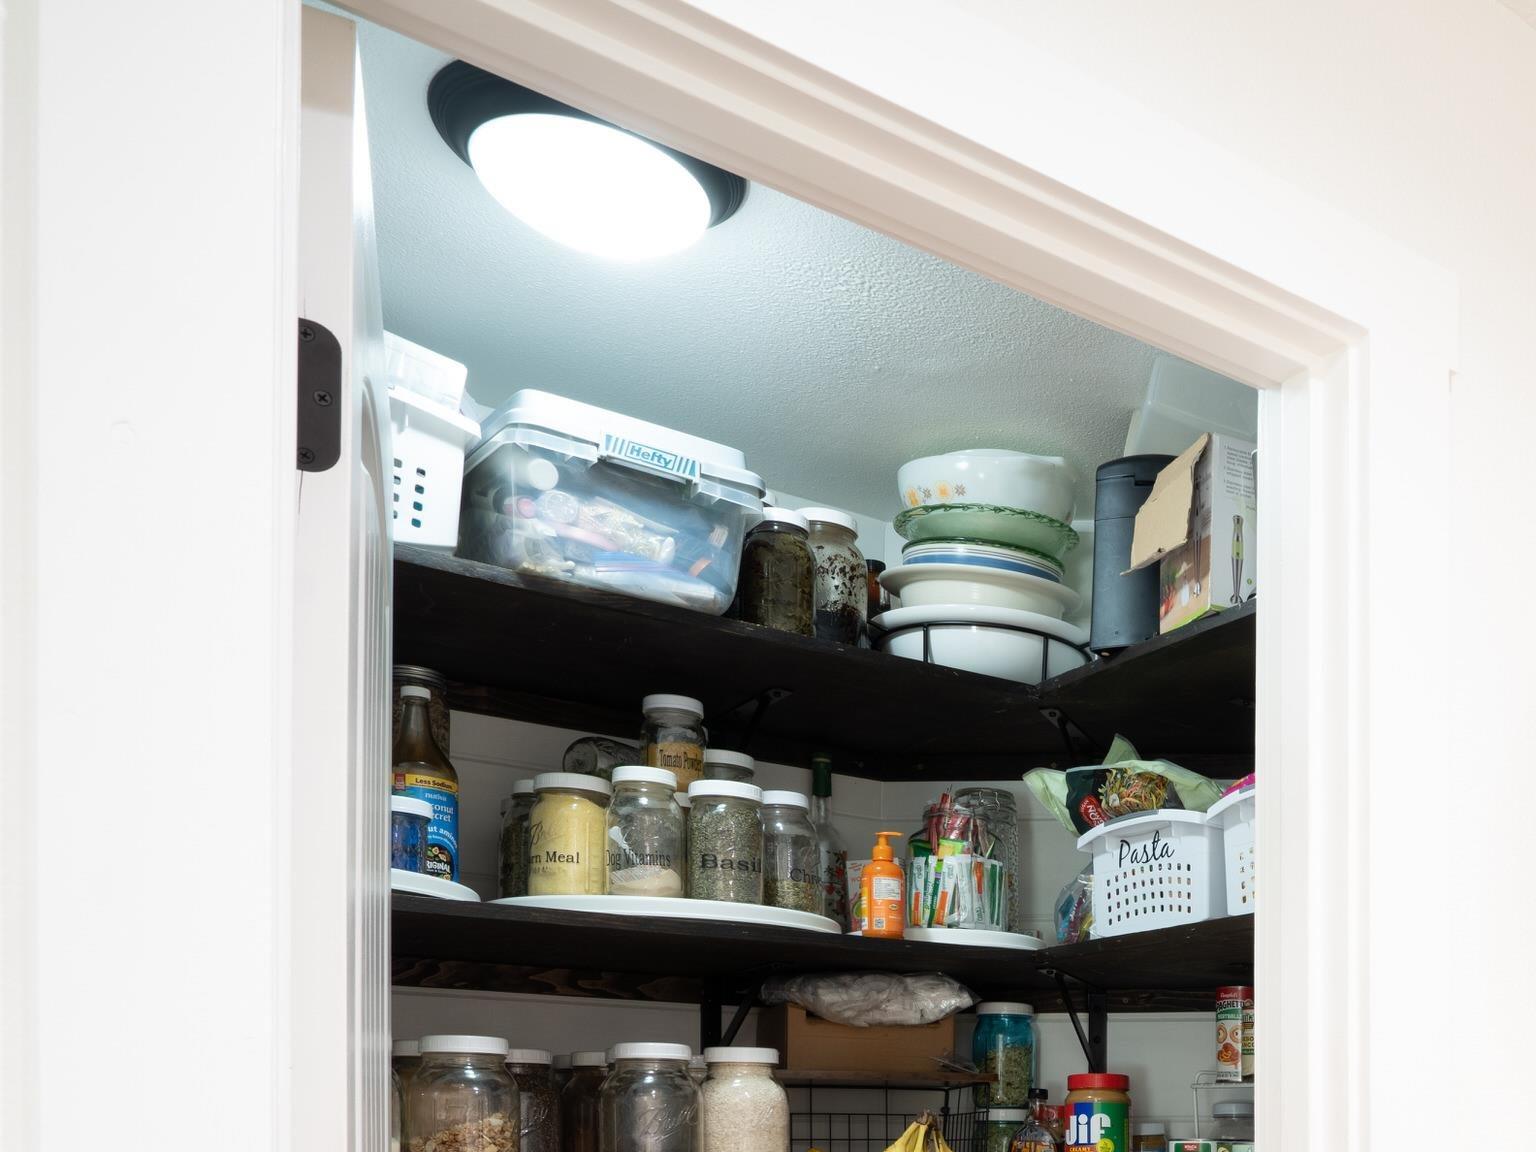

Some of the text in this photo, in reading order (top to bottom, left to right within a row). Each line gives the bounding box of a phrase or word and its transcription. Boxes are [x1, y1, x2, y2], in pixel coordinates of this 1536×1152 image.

[629, 444, 673, 469] Hefty
[659, 749, 683, 768] Tomato
[415, 777, 432, 785] Less
[545, 850, 580, 865] Meal
[606, 849, 671, 870] Dog Vitamins
[1118, 830, 1175, 868] Pasta
[426, 860, 451, 874] RIGINAL
[700, 852, 762, 874] Basil
[1065, 1113, 1111, 1146] Jif
